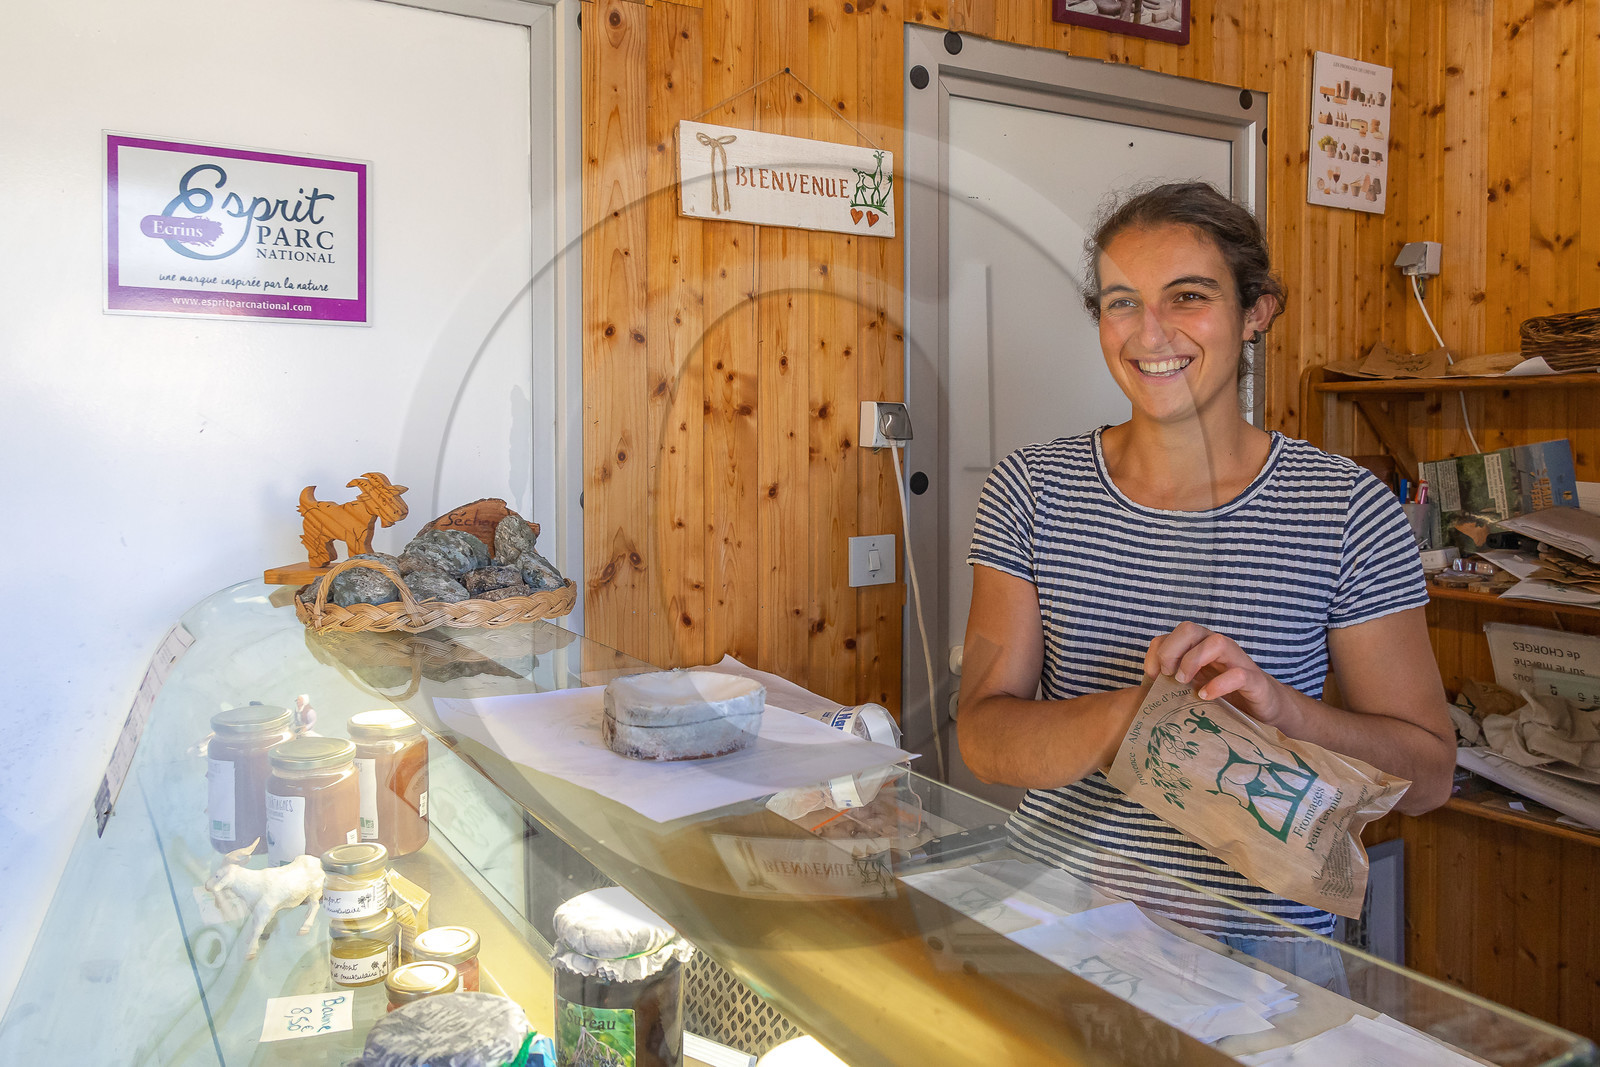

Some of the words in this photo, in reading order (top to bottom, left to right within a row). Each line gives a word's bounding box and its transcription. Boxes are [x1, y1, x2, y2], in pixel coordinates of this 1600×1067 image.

[735, 165, 850, 199] BIENVENUE
[163, 164, 335, 260] Esprit
[153, 220, 203, 238] Ecrins
[256, 225, 334, 250] PARC
[256, 248, 336, 264] NATIONAL
[159, 272, 177, 282] une
[180, 275, 218, 287] marque
[220, 275, 261, 289] inspirée
[263, 279, 282, 291] par
[284, 277, 295, 290] la
[296, 279, 329, 292] nature
[172, 296, 312, 312] www.espritparcnational.com
[1512, 641, 1564, 658] CHORGES
[1566, 650, 1580, 661] de
[1143, 700, 1162, 716] Côte
[1128, 721, 1143, 745] Alpes
[1128, 752, 1148, 786] Provence
[1293, 786, 1324, 838] Fromages
[1305, 818, 1323, 851] Petit
[1319, 787, 1344, 827] fermier
[317, 995, 346, 1033] Baume
[567, 1009, 616, 1030] Sureau
